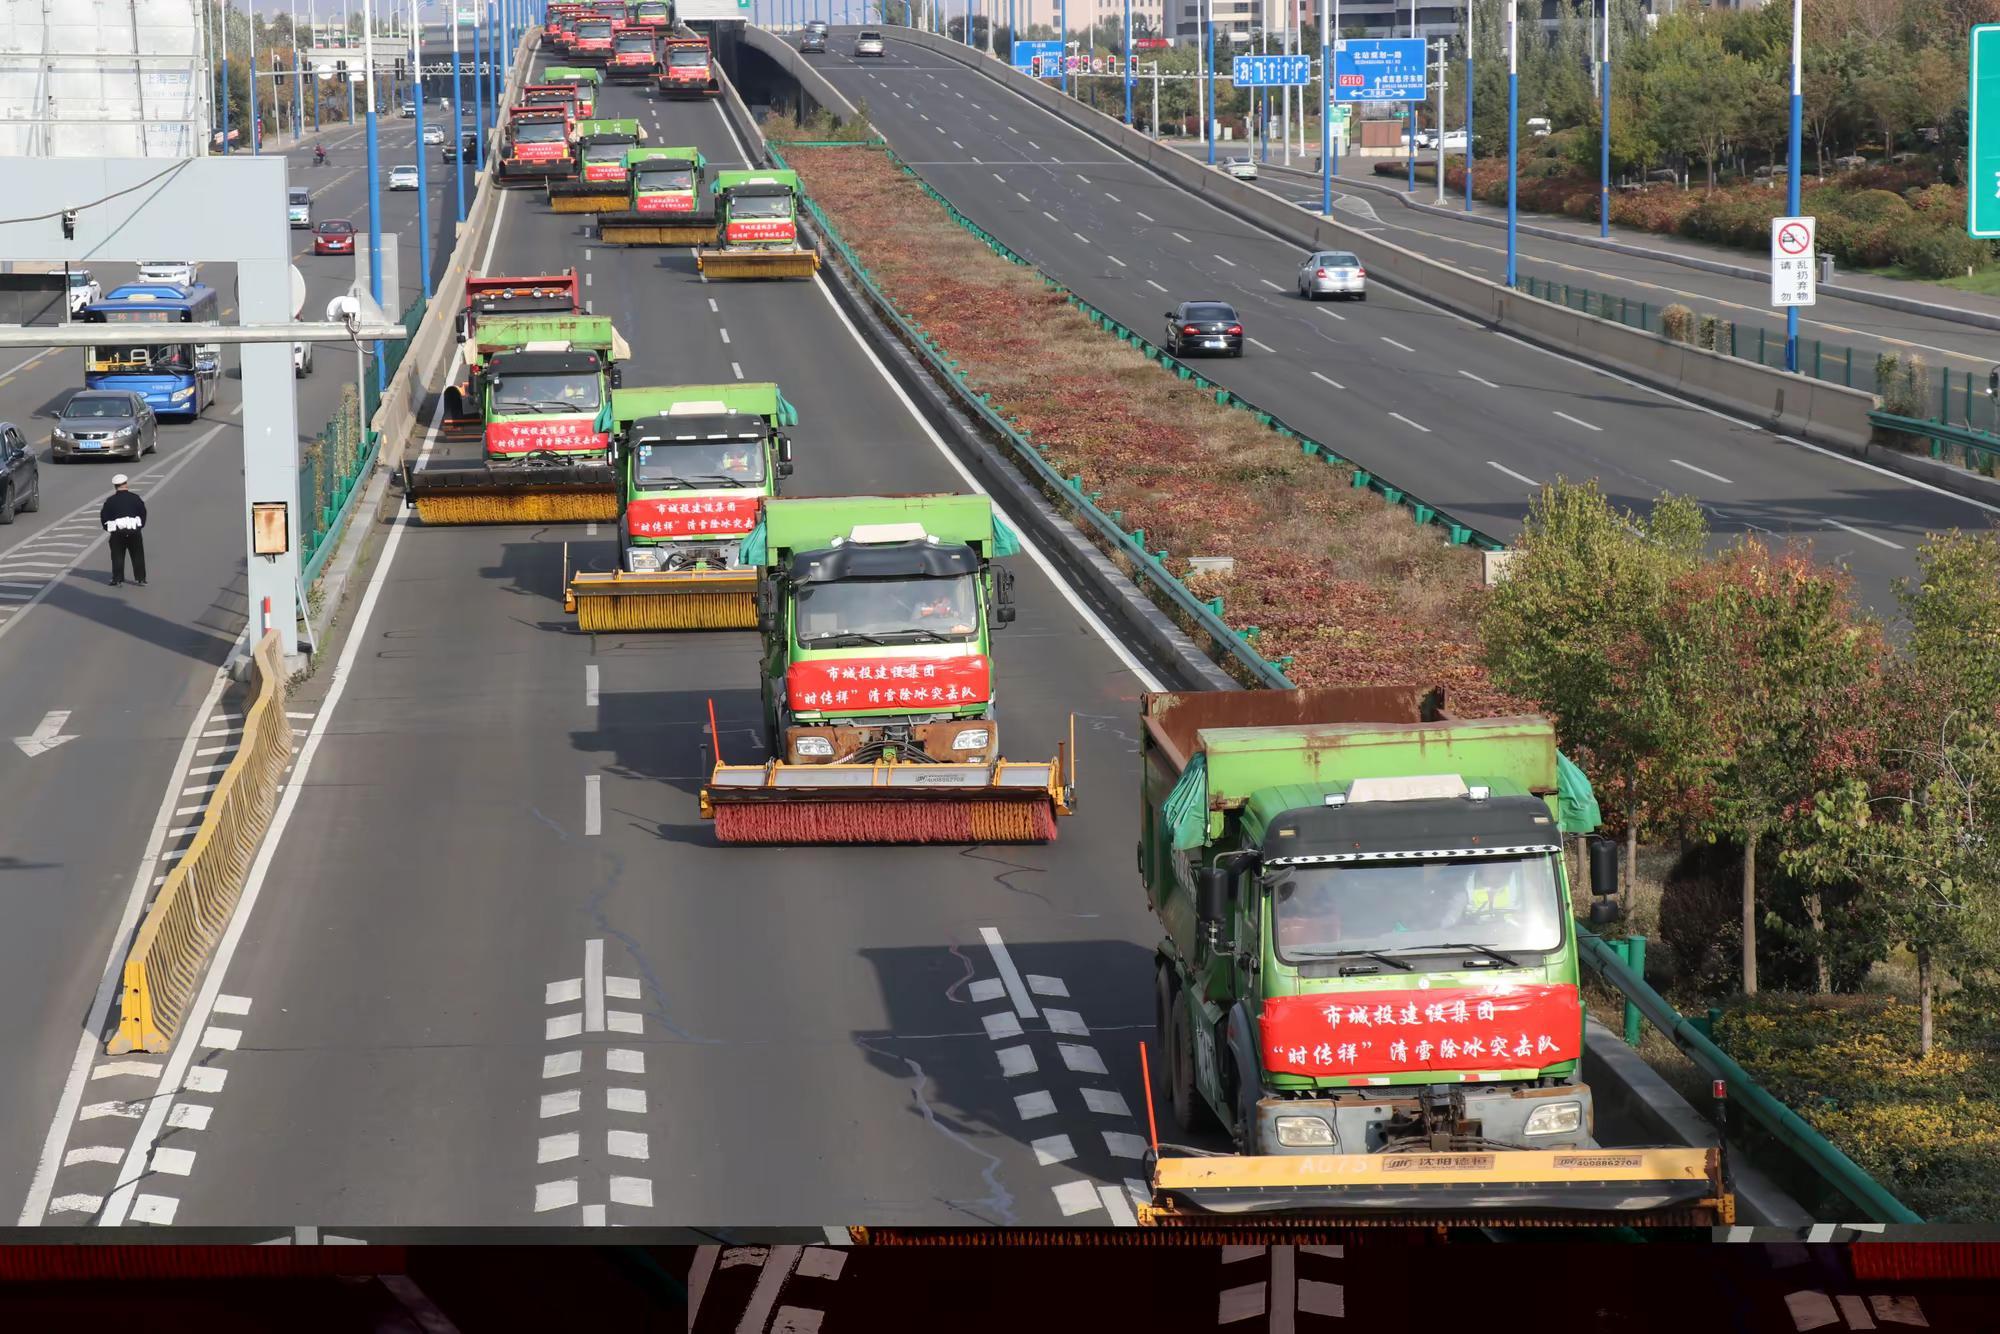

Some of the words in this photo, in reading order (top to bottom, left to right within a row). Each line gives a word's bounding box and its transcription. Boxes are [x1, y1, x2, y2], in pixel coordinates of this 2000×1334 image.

[1341, 76, 1362, 85] G110
[656, 501, 737, 515] 市城投建设集团
[826, 664, 936, 682] 市城投建设集团
[868, 683, 977, 704] 清雪除冰突击队
[1322, 1000, 1496, 1031] 市城投建设集团
[1389, 1033, 1561, 1064] 清雪除冰突击队
[1419, 1156, 1488, 1166] 沈阳德恒
